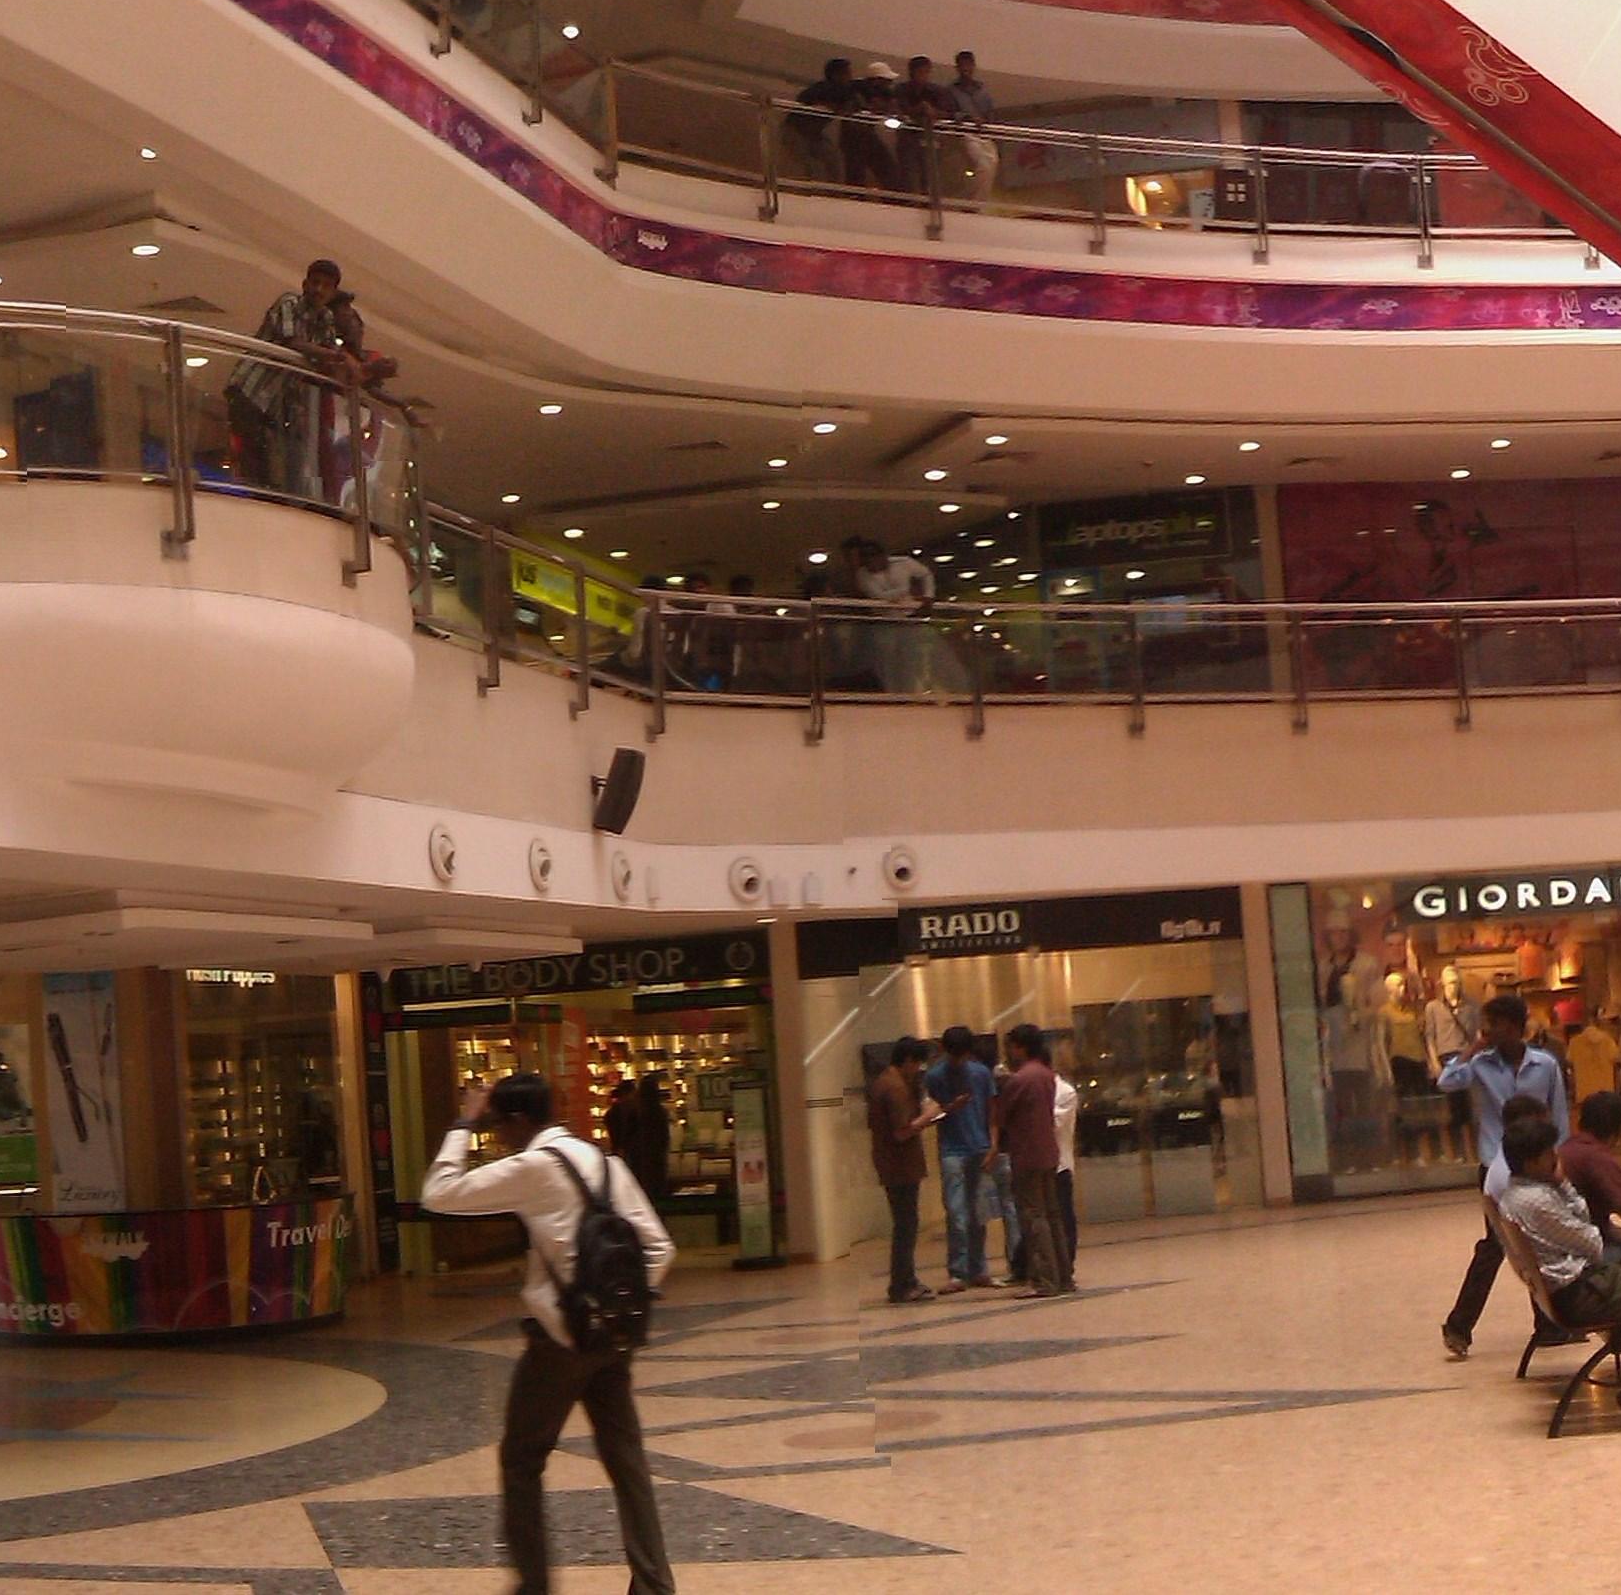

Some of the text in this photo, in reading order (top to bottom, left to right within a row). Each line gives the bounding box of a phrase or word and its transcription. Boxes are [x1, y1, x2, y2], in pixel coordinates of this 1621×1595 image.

[920, 909, 1021, 939] RADO
[412, 948, 684, 998] THE BODY SHOP
[267, 1217, 330, 1248] Travel
